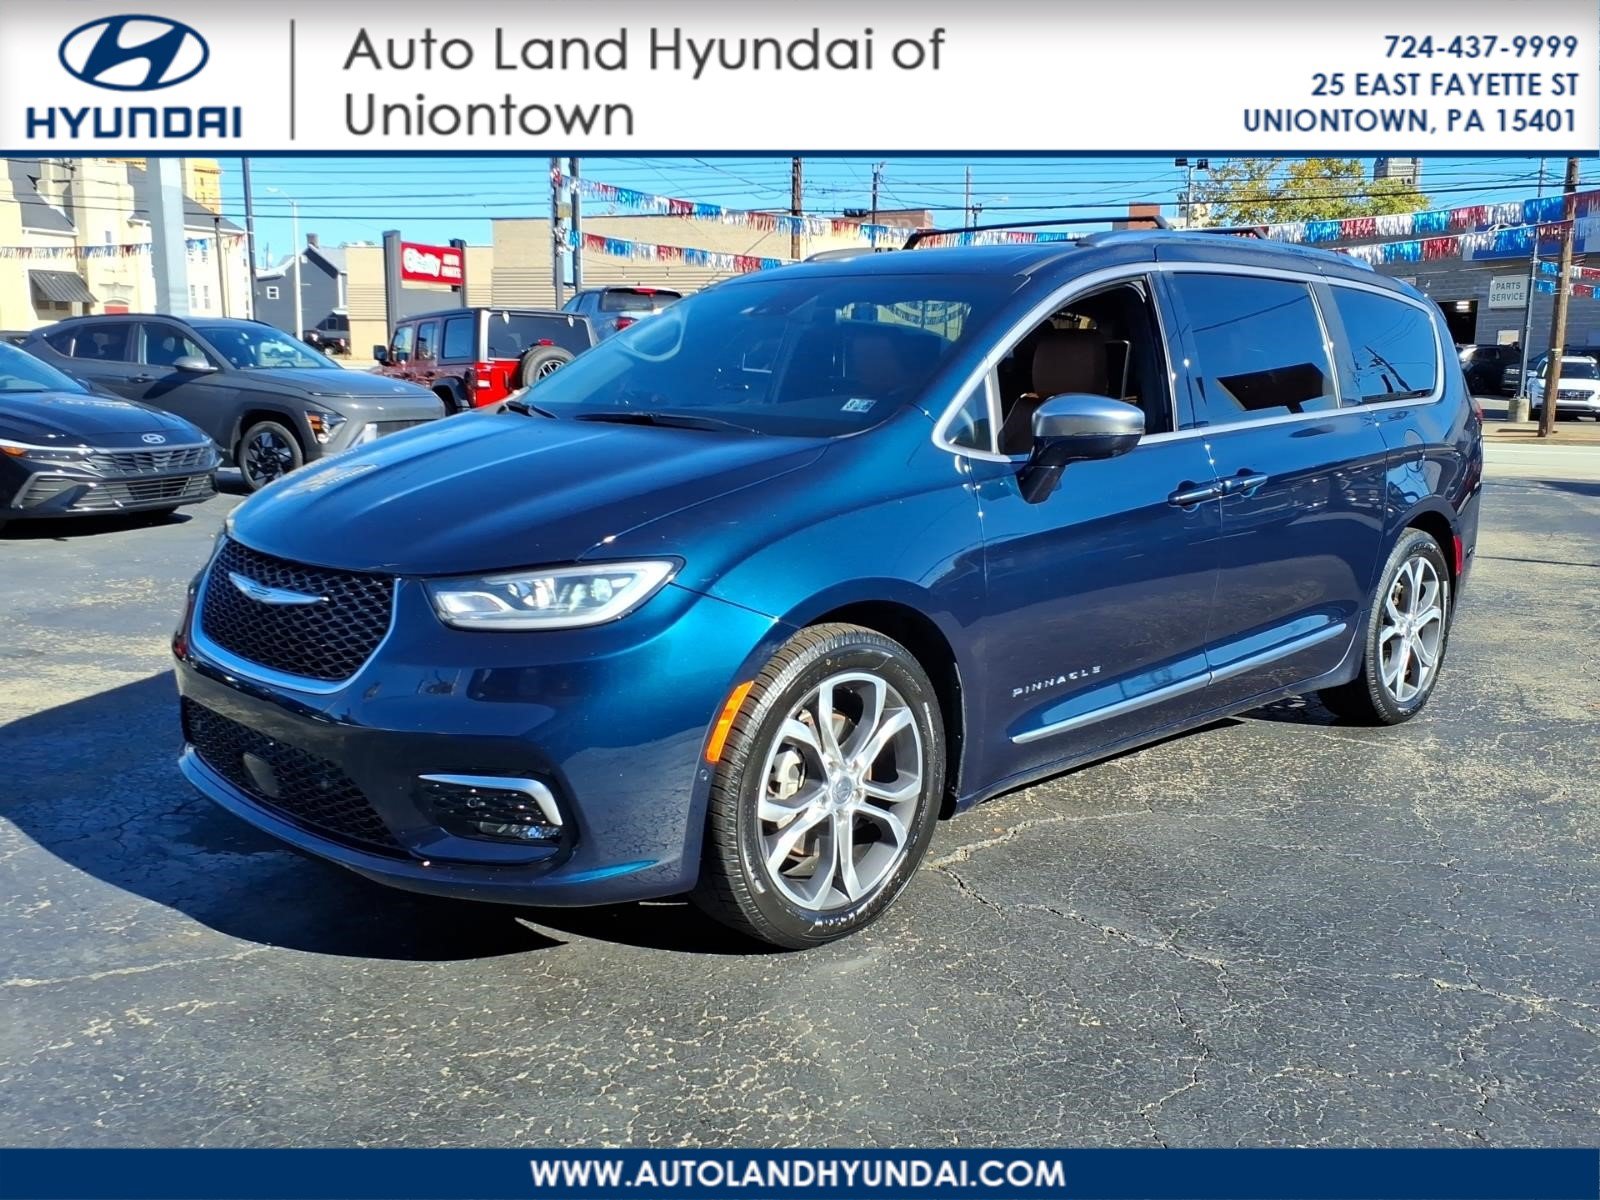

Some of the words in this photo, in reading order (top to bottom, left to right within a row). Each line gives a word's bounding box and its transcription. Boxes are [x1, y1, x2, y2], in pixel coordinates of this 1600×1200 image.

[1495, 281, 1521, 291] PARTS
[1490, 292, 1525, 302] SERVICE
[1012, 665, 1102, 698] PINNACLE
